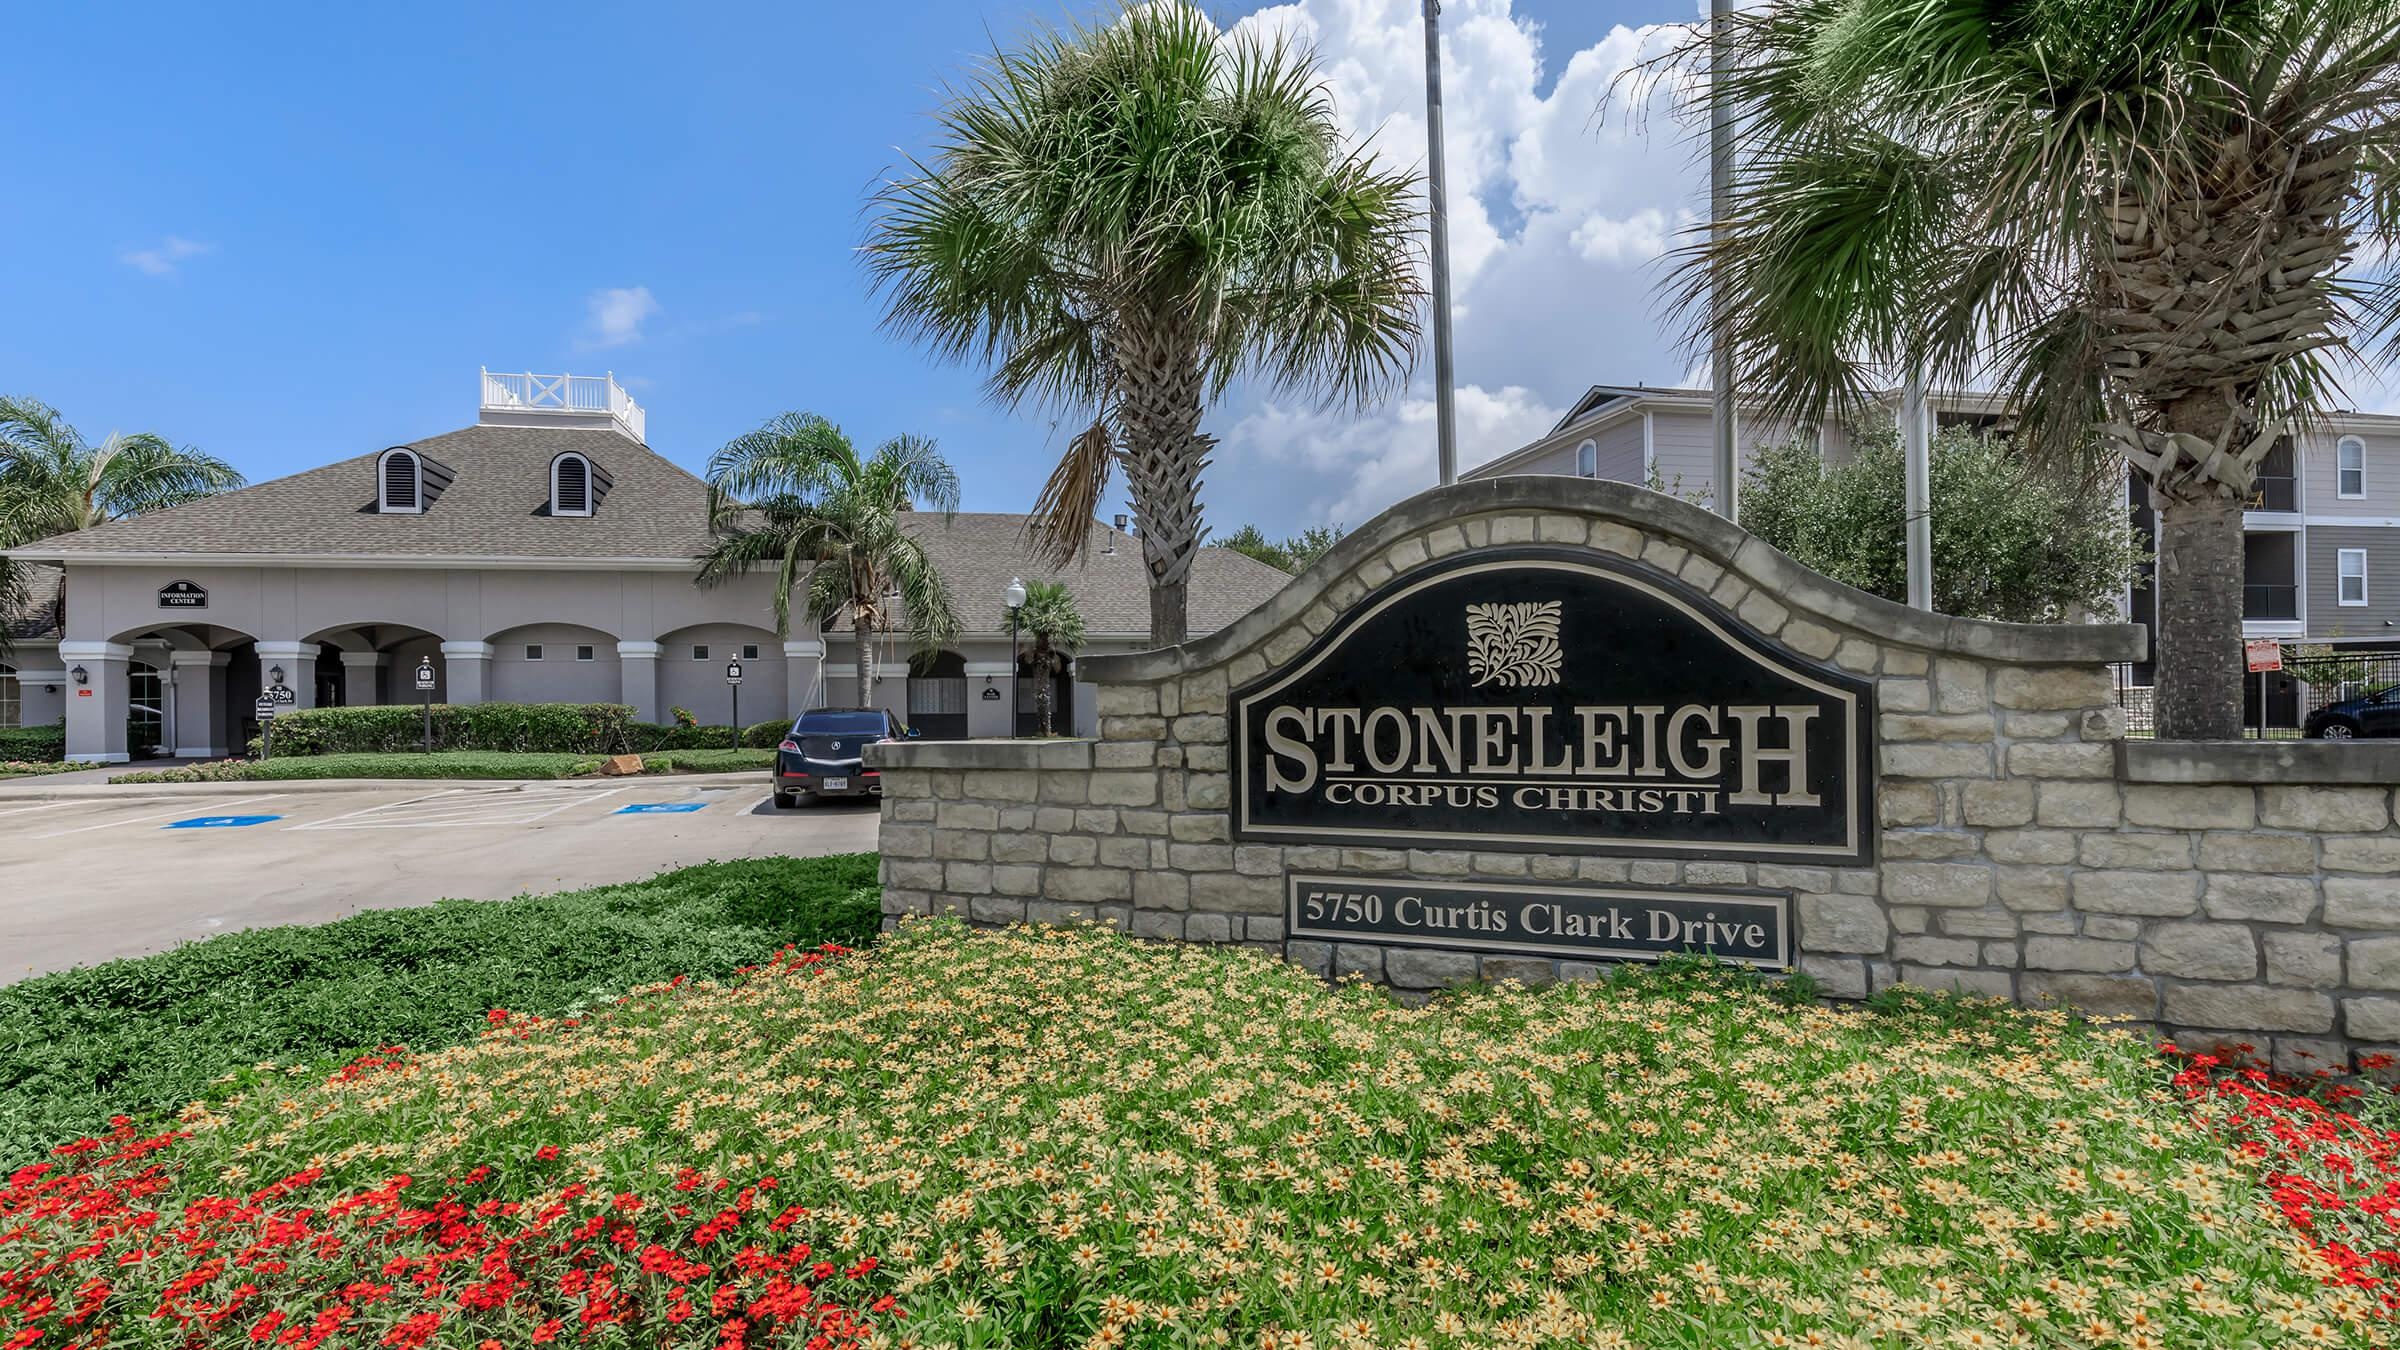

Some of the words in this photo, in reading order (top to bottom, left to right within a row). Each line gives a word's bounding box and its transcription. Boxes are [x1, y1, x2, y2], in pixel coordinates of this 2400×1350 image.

[1264, 703, 1821, 807] STONELEIGH
[1324, 783, 1500, 809] CORPUS
[1513, 786, 1721, 815] CHRISTI
[1306, 891, 1383, 924] 5750
[1394, 896, 1508, 932] Curtis
[1519, 903, 1636, 941] Clark
[1645, 909, 1766, 949] Drive
